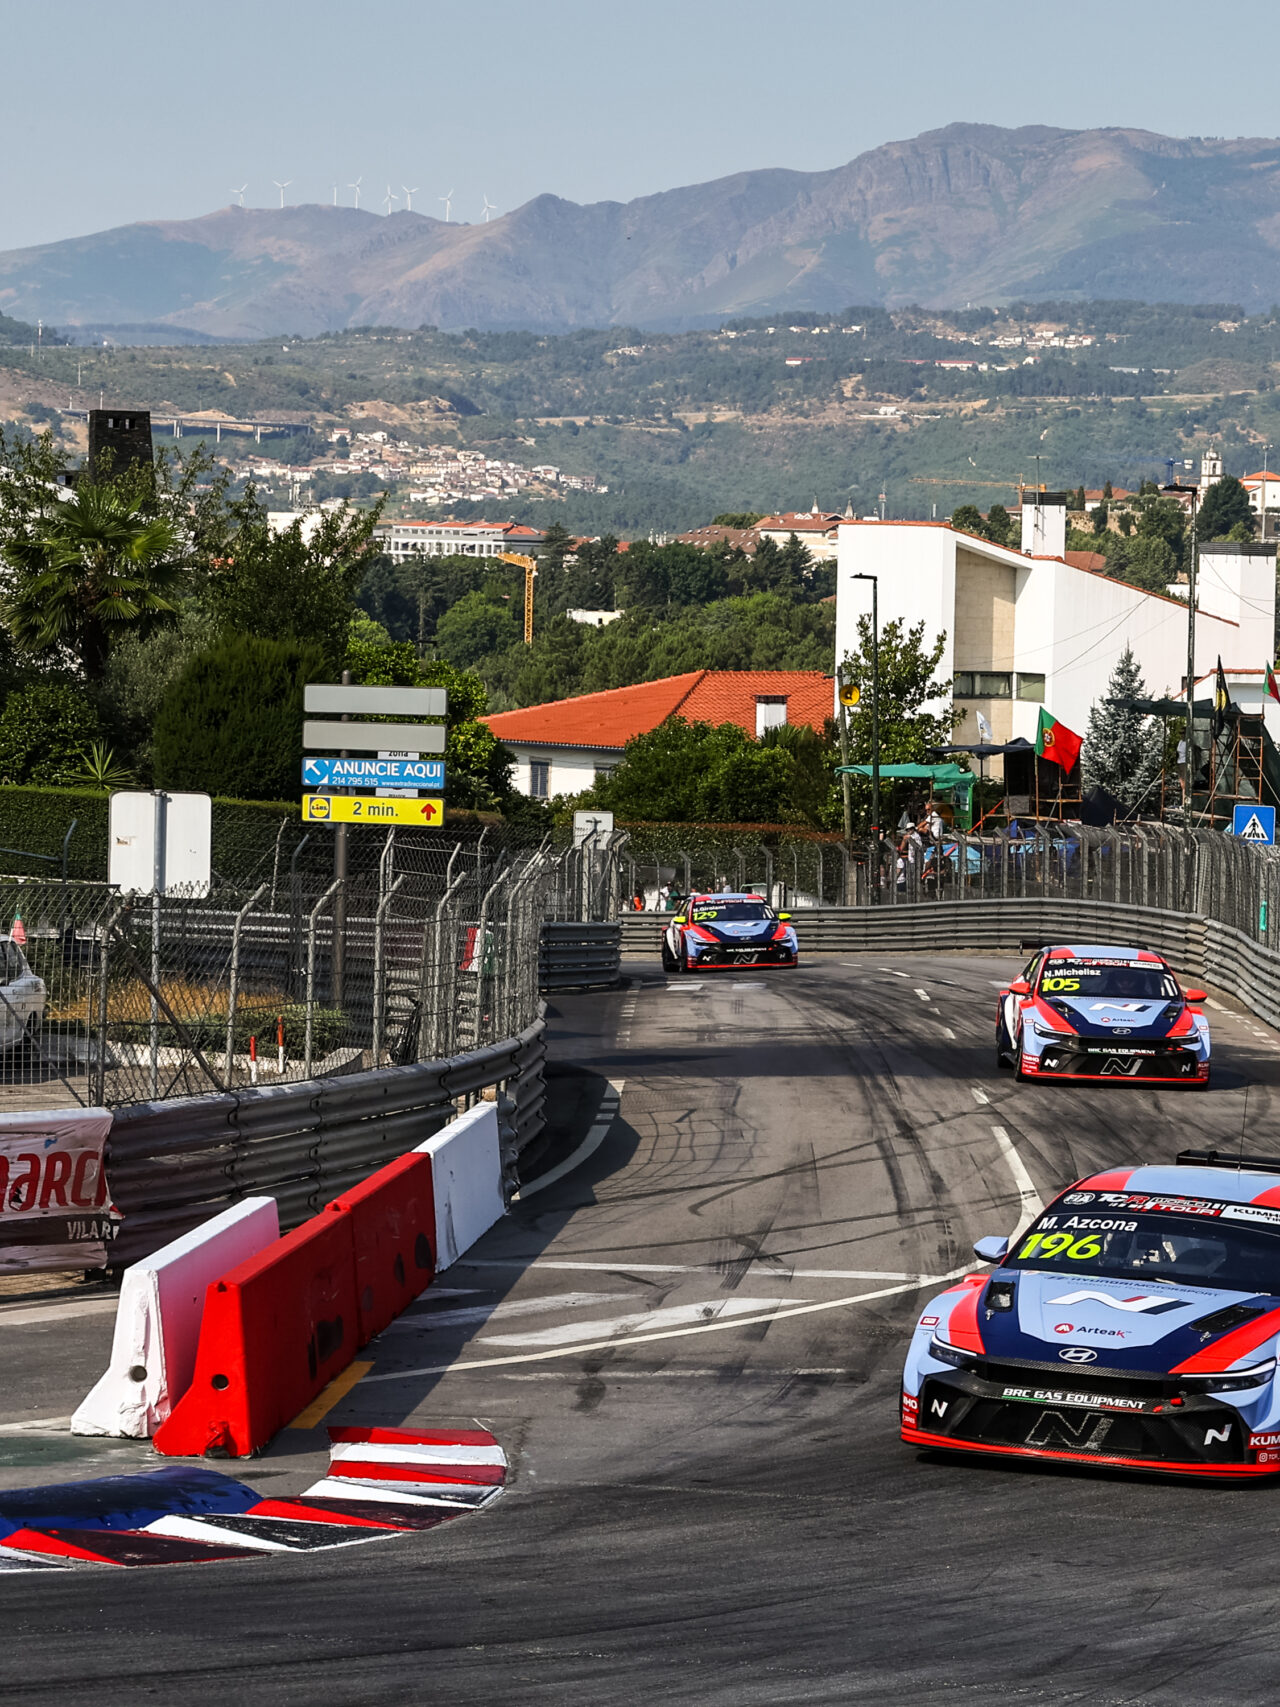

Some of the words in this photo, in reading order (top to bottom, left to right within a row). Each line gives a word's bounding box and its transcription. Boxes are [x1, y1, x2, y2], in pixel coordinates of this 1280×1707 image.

[332, 761, 400, 776] ANUNCIE
[403, 763, 441, 778] AQUI
[332, 777, 346, 785] 214
[347, 777, 363, 786] 795
[364, 777, 379, 786] 515
[353, 801, 362, 815] 2
[368, 803, 399, 817] min.
[693, 911, 718, 921] 129
[1041, 978, 1080, 992] 105
[1064, 1193, 1094, 1204] FIA
[1099, 1193, 1150, 1204] TCR
[1160, 1203, 1216, 1216] TOUR
[67, 1221, 99, 1240] VILA
[1037, 1216, 1059, 1230] M.
[1062, 1216, 1138, 1232] Azcona
[1017, 1232, 1102, 1260] 196
[1071, 1278, 1134, 1286] HYUNDAI
[1135, 1283, 1220, 1297] MOTORSPORT
[1077, 1325, 1126, 1339] Arteak
[1003, 1388, 1032, 1397] BRC
[1034, 1391, 1062, 1401] GAS
[1066, 1392, 1146, 1409] EQUIPMENT
